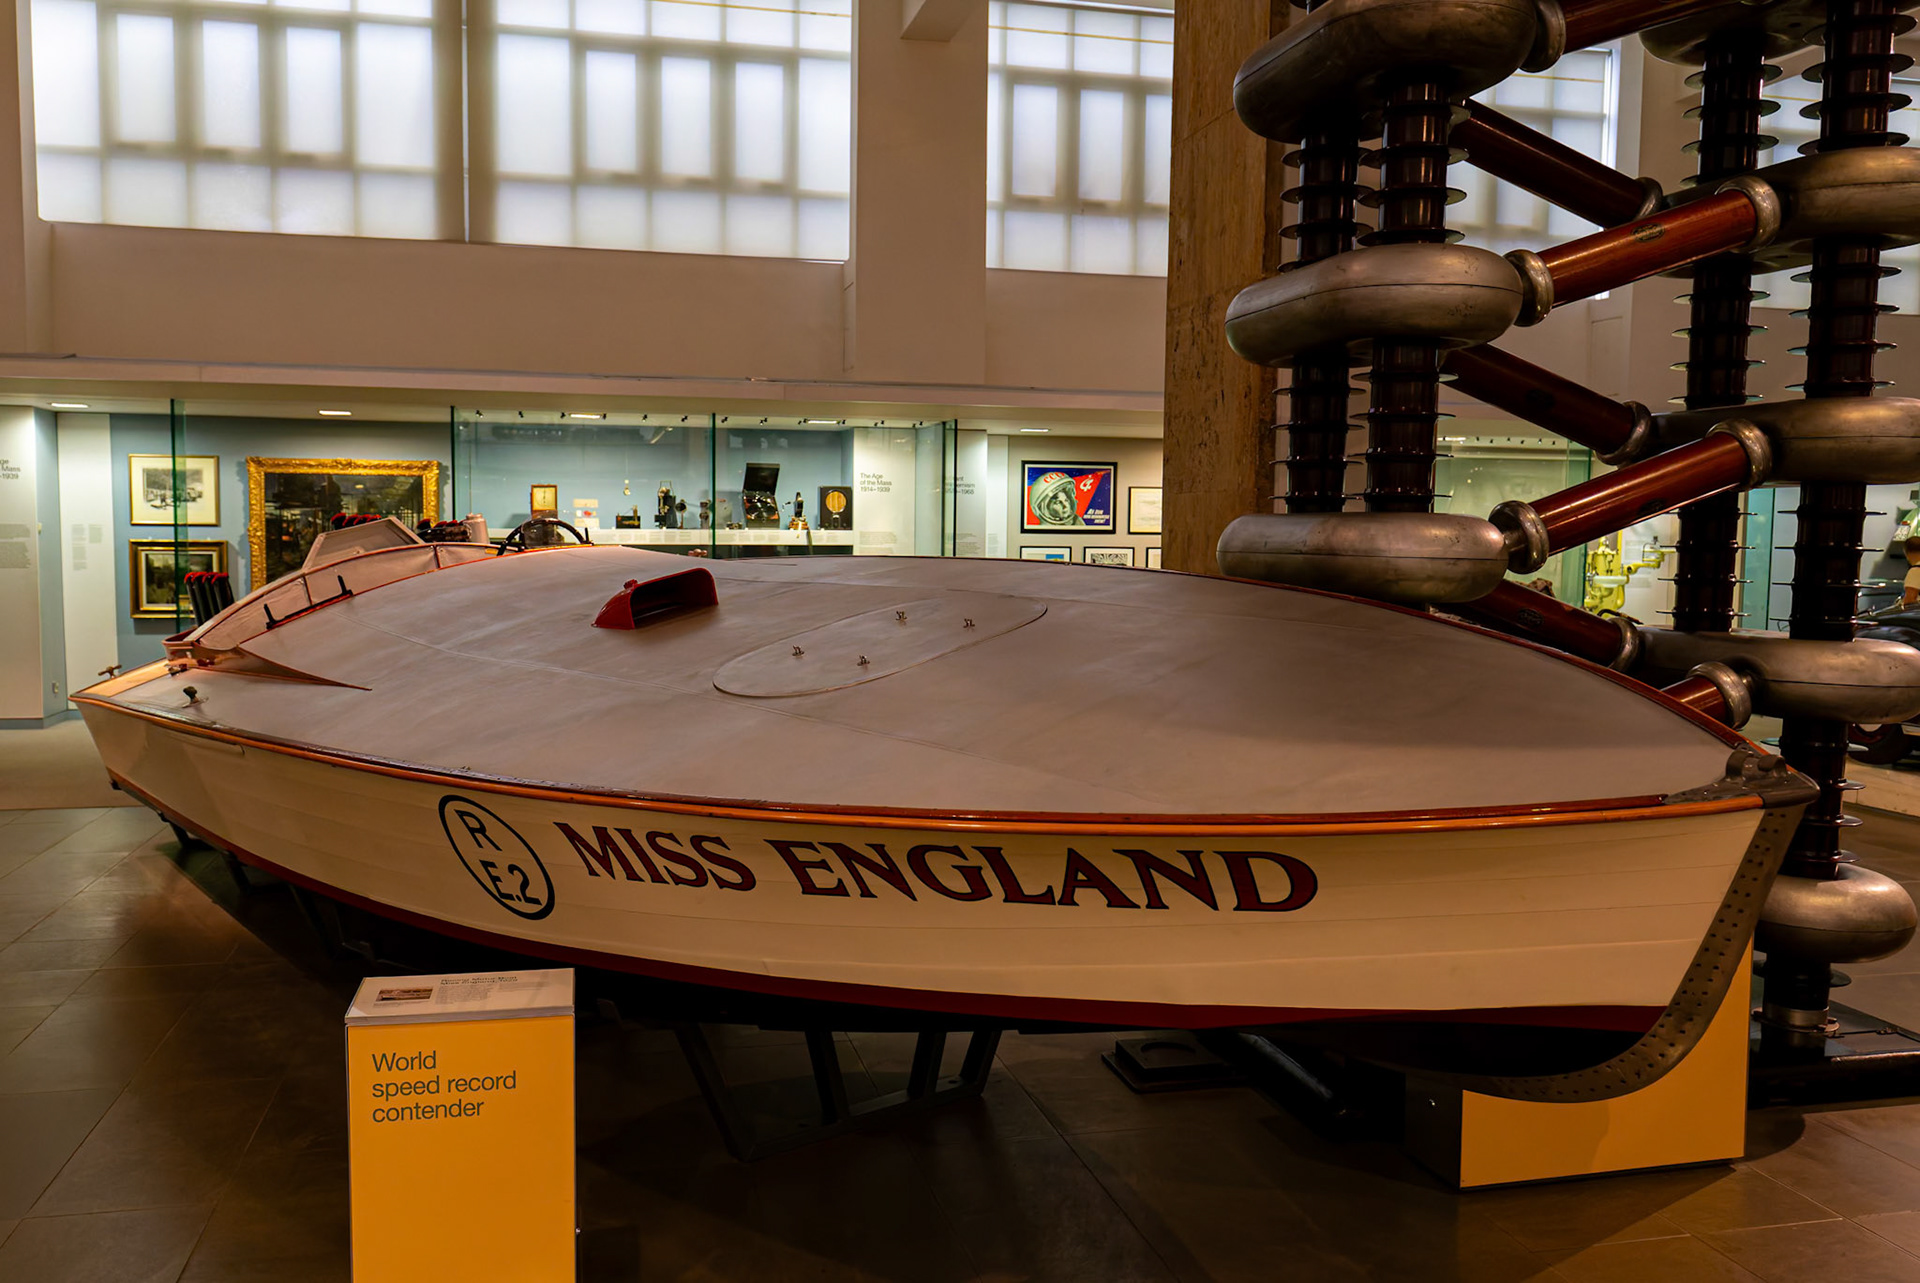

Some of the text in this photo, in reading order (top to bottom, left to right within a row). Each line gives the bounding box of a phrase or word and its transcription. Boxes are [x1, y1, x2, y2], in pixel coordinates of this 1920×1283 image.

[453, 808, 503, 852] R
[553, 821, 1319, 912] MISS ENGLAND
[371, 1050, 437, 1073] World
[371, 1070, 517, 1102] speed record
[372, 1099, 485, 1123] contender
